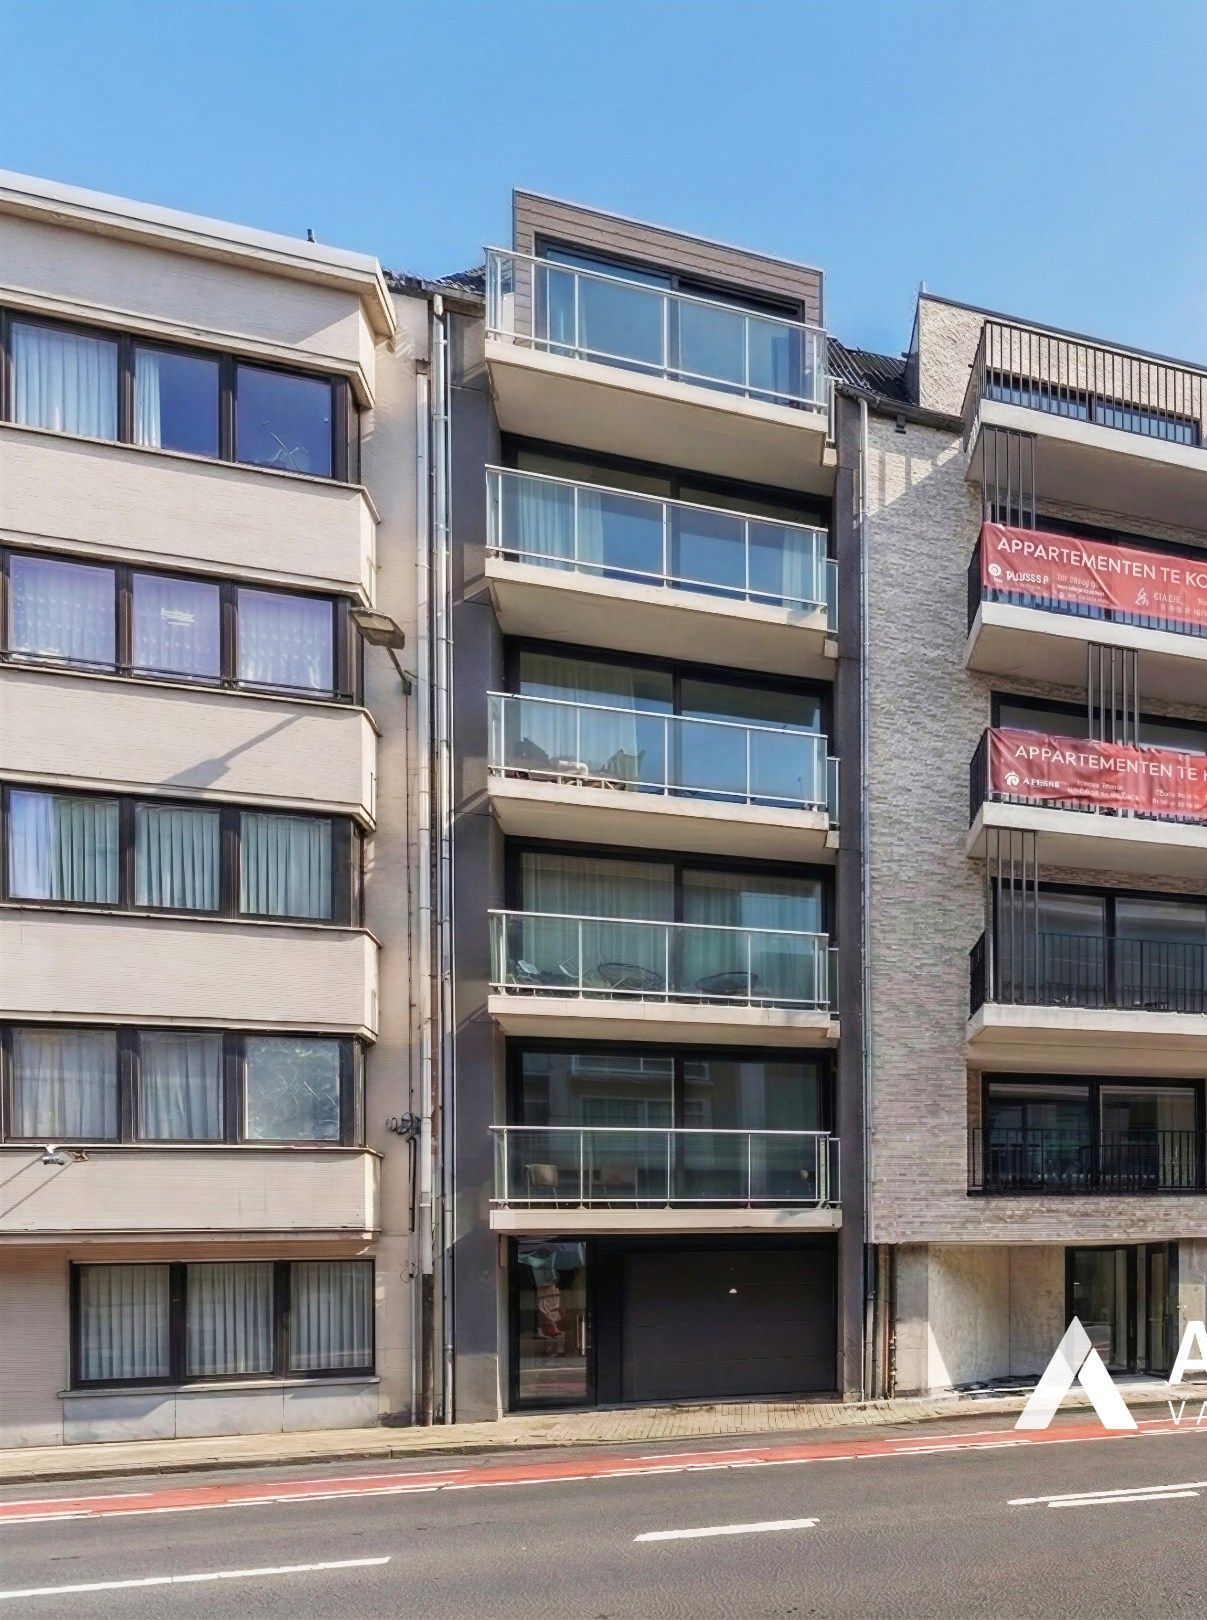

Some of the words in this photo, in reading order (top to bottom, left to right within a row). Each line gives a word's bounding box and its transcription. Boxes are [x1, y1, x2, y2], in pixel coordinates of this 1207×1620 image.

[996, 537, 1156, 582] APPARTEMENTEN
[1160, 567, 1180, 584] TE
[1014, 745, 1172, 778] APPARTEMENTEN
[1177, 765, 1197, 781] TE
